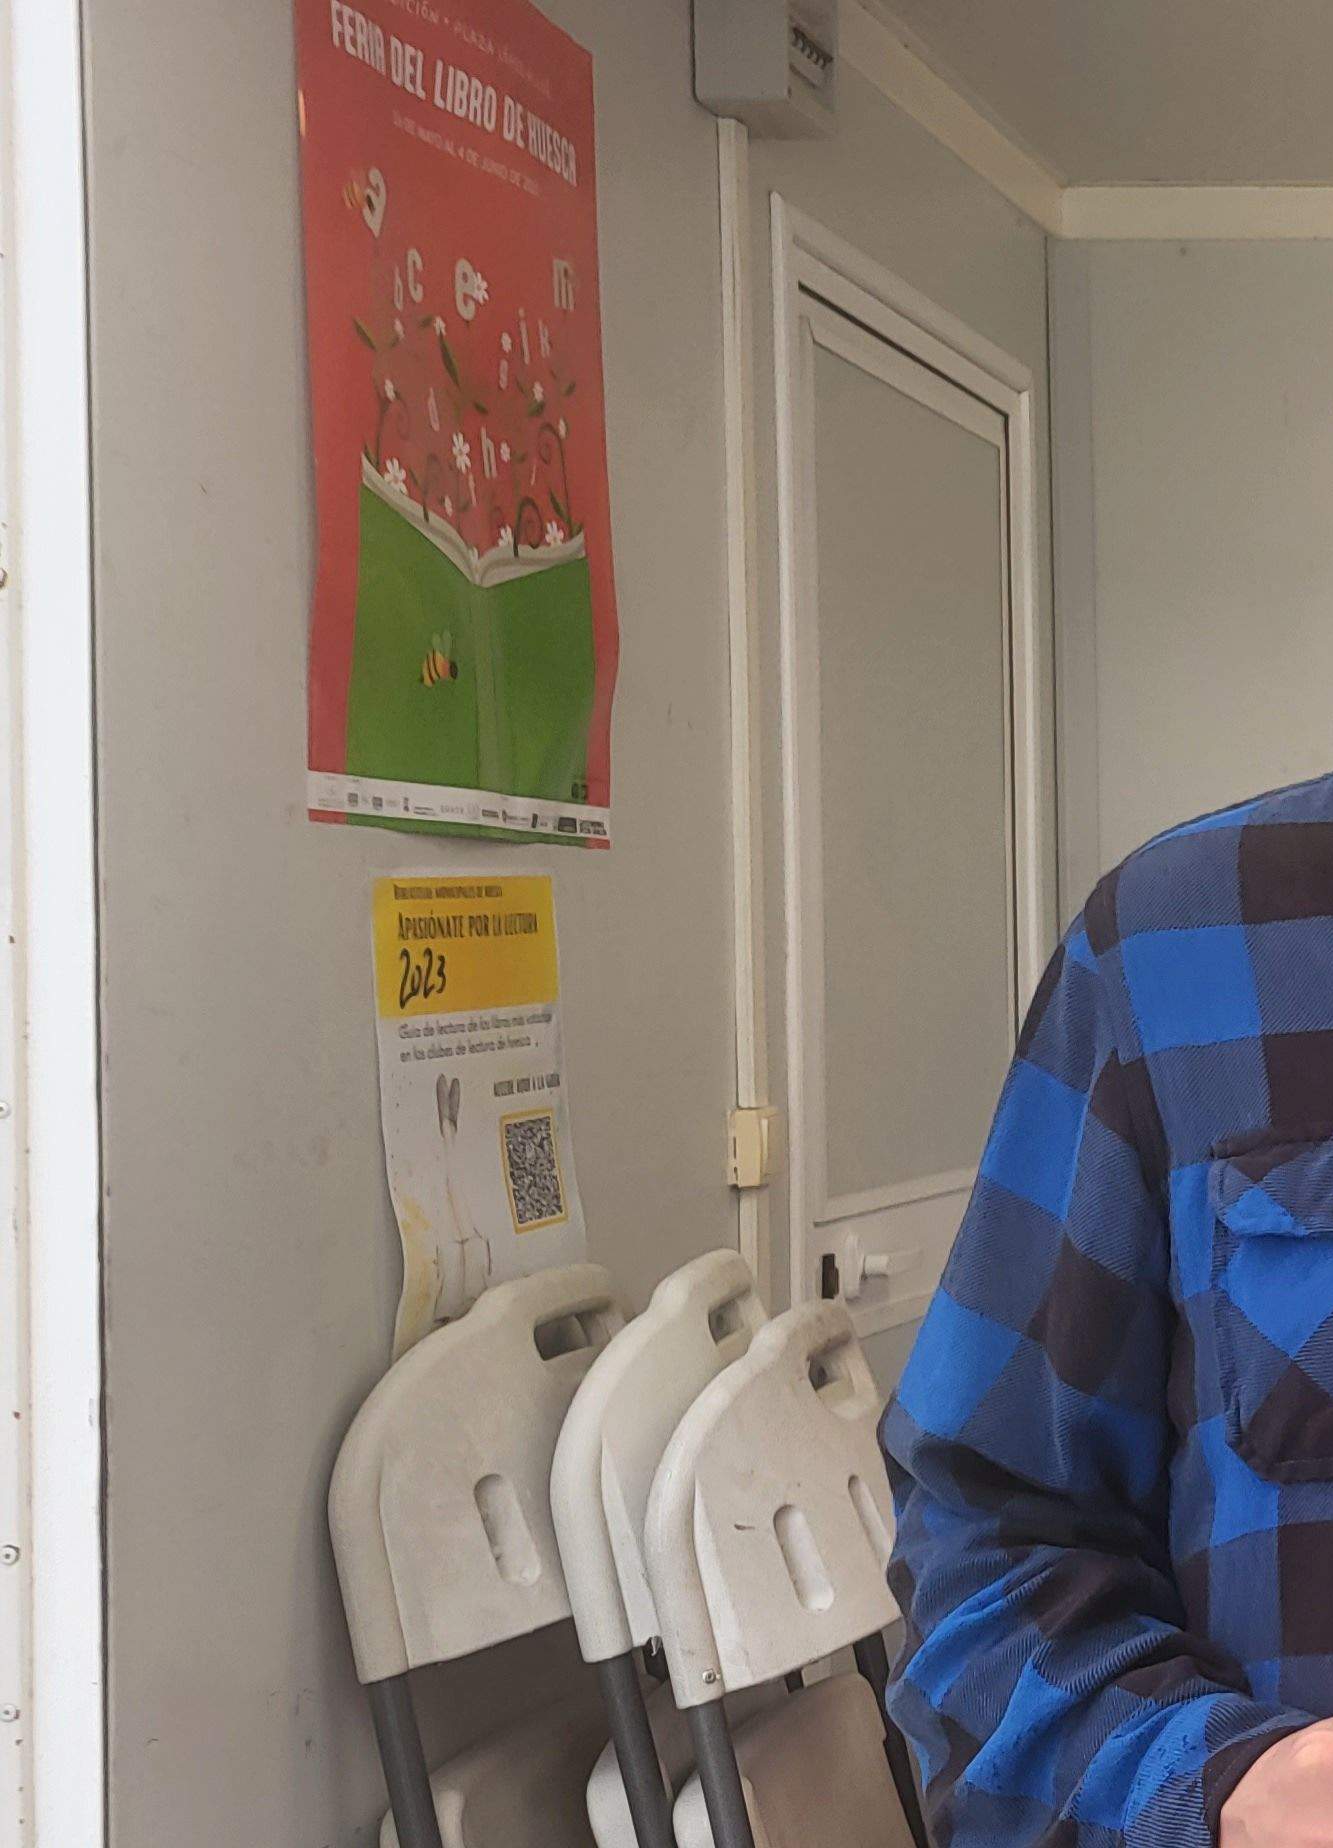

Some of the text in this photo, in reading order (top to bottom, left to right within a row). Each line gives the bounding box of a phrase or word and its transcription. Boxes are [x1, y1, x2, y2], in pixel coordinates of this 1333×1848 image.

[331, 1, 386, 76] FERIA
[390, 35, 426, 100] DEL
[434, 59, 497, 132] LIBRO
[503, 95, 525, 149] DE
[527, 111, 577, 187] HUESCA
[398, 910, 464, 940] APASIÓNATE
[469, 915, 489, 938] POR
[400, 948, 447, 1009] 2023
